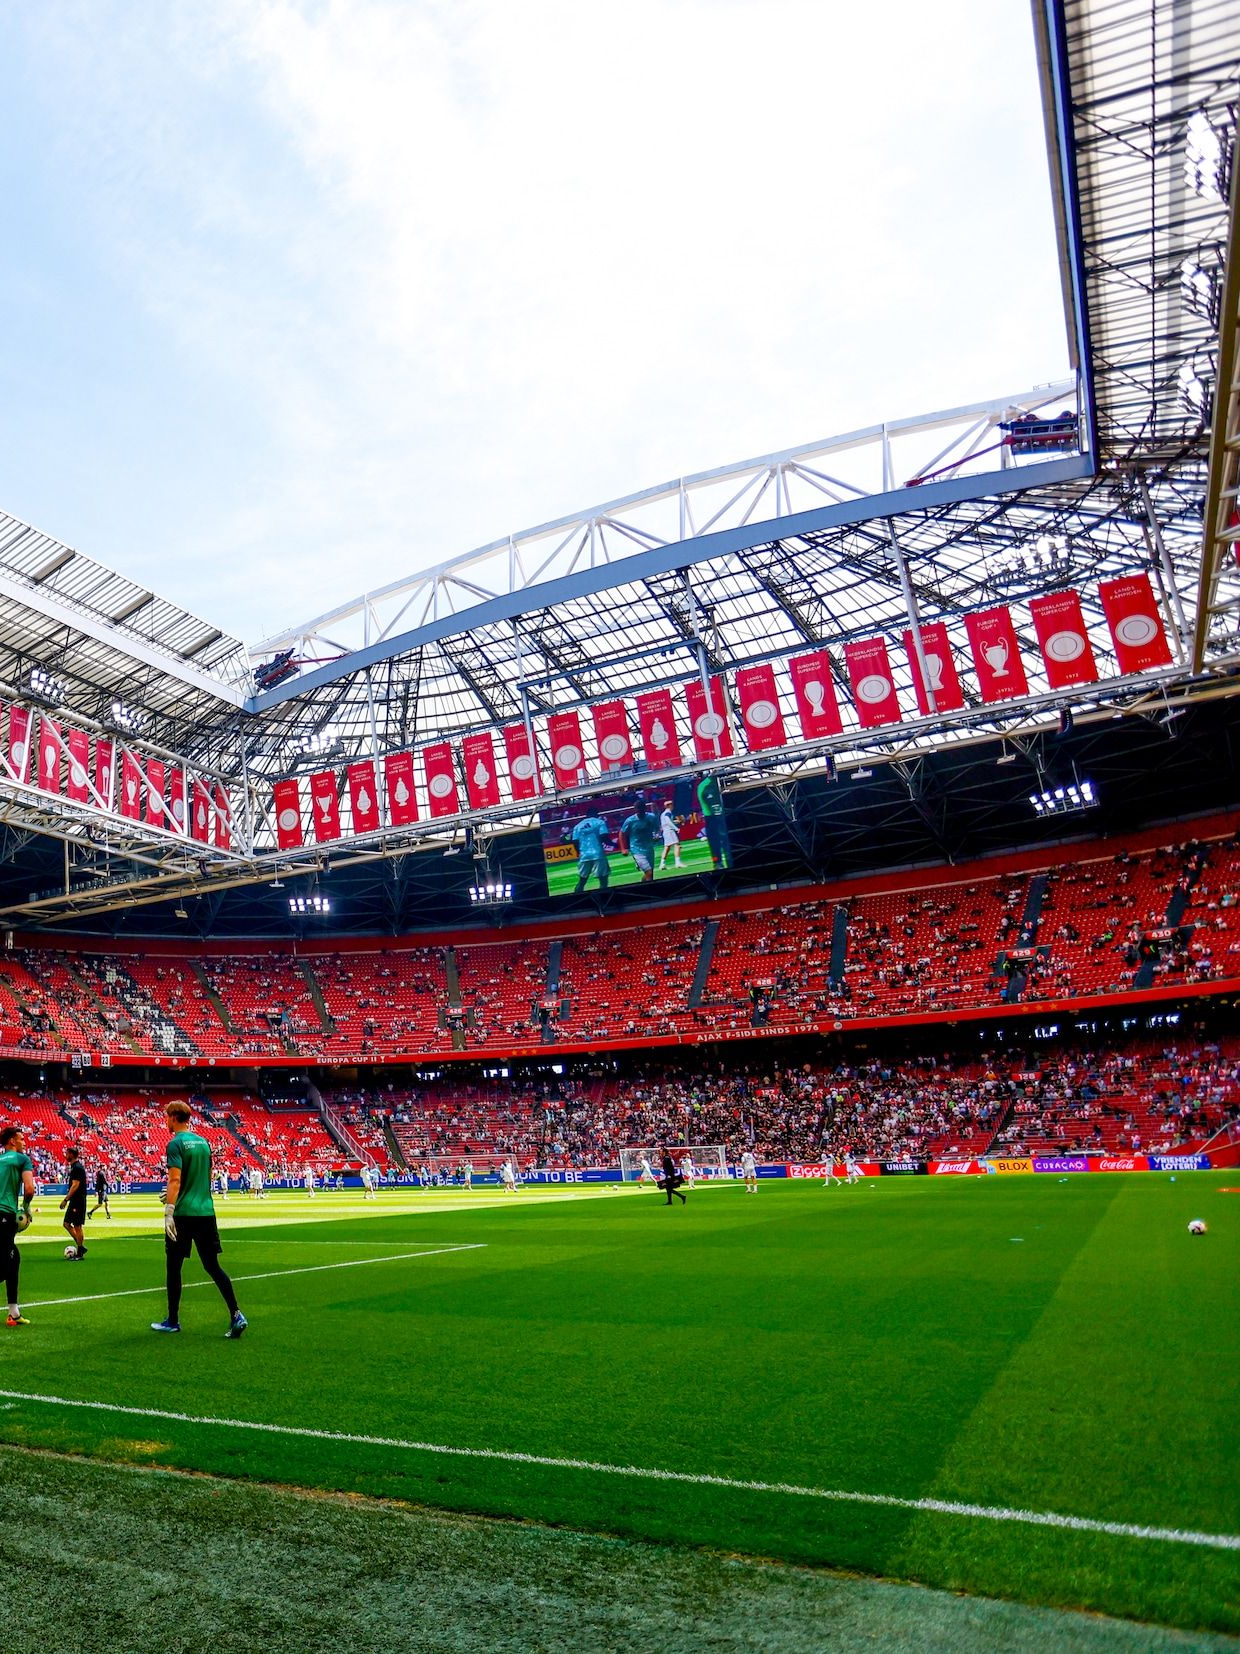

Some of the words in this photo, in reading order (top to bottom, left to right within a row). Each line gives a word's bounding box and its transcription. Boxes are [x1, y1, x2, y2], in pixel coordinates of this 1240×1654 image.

[1114, 586, 1136, 594] LANDS
[1110, 590, 1142, 600] KAMPIOEN
[1034, 600, 1075, 614] NEDERLANDSE
[1040, 606, 1070, 616] SUPERCUP
[976, 618, 999, 628] EUROPA
[847, 646, 883, 658] NEDERLANDSE
[853, 652, 879, 660] SUPERCUP
[796, 661, 820, 670] EUROPESE
[797, 666, 821, 674] SUPERCUP
[743, 678, 768, 687] KAMPIOEN
[546, 848, 573, 860] BLOX
[1152, 930, 1171, 938] 430
[1012, 949, 1031, 958] 429
[696, 1032, 722, 1042] AJAX
[726, 1030, 756, 1039] F-SIDE
[760, 1027, 790, 1036] SINDS
[795, 1024, 819, 1032] 1976
[1154, 1156, 1202, 1164] VRIENDEN
[999, 1162, 1028, 1171] BLOX
[437, 1175, 453, 1186] BE
[544, 1172, 559, 1182] TO
[565, 1172, 582, 1182] BE
[285, 1179, 300, 1188] TO
[120, 1184, 131, 1193] BE
